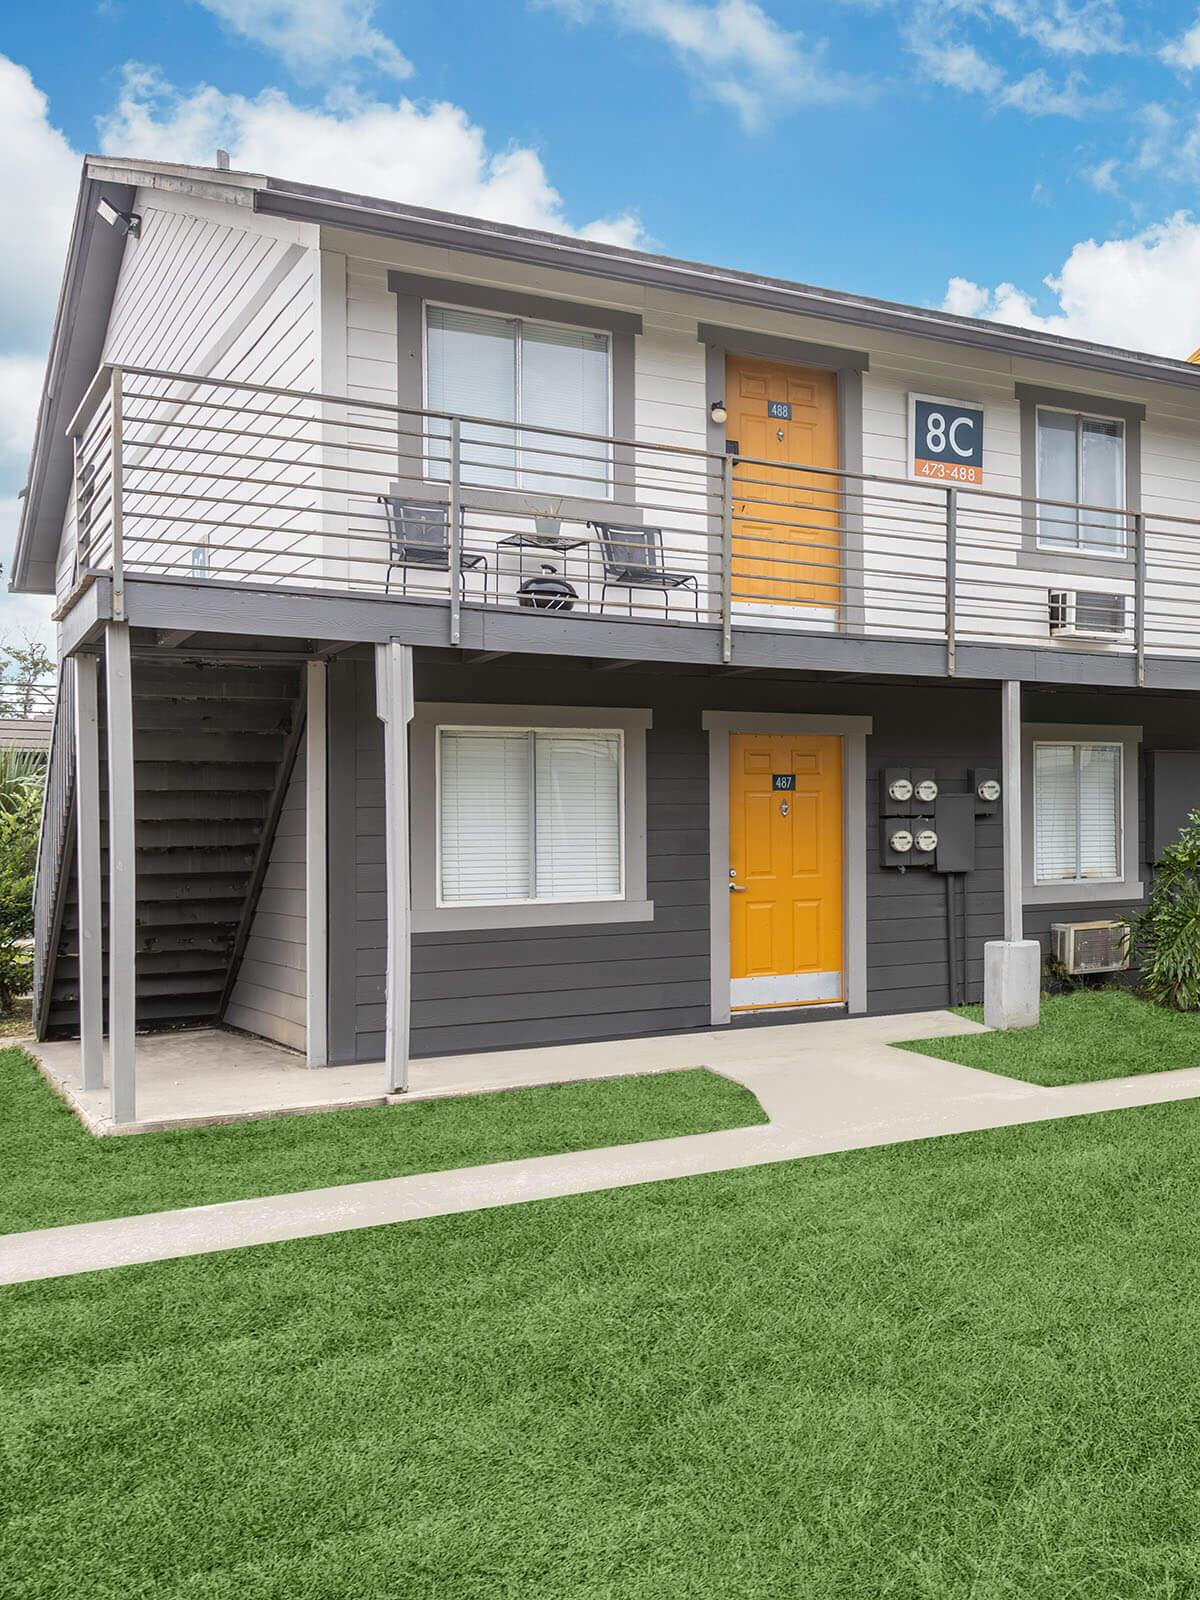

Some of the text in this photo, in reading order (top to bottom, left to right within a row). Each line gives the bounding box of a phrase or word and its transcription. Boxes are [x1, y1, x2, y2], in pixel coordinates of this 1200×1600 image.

[771, 404, 788, 417] 488
[926, 412, 974, 457] 8C
[921, 463, 975, 481] 473-488
[775, 776, 792, 788] 487
